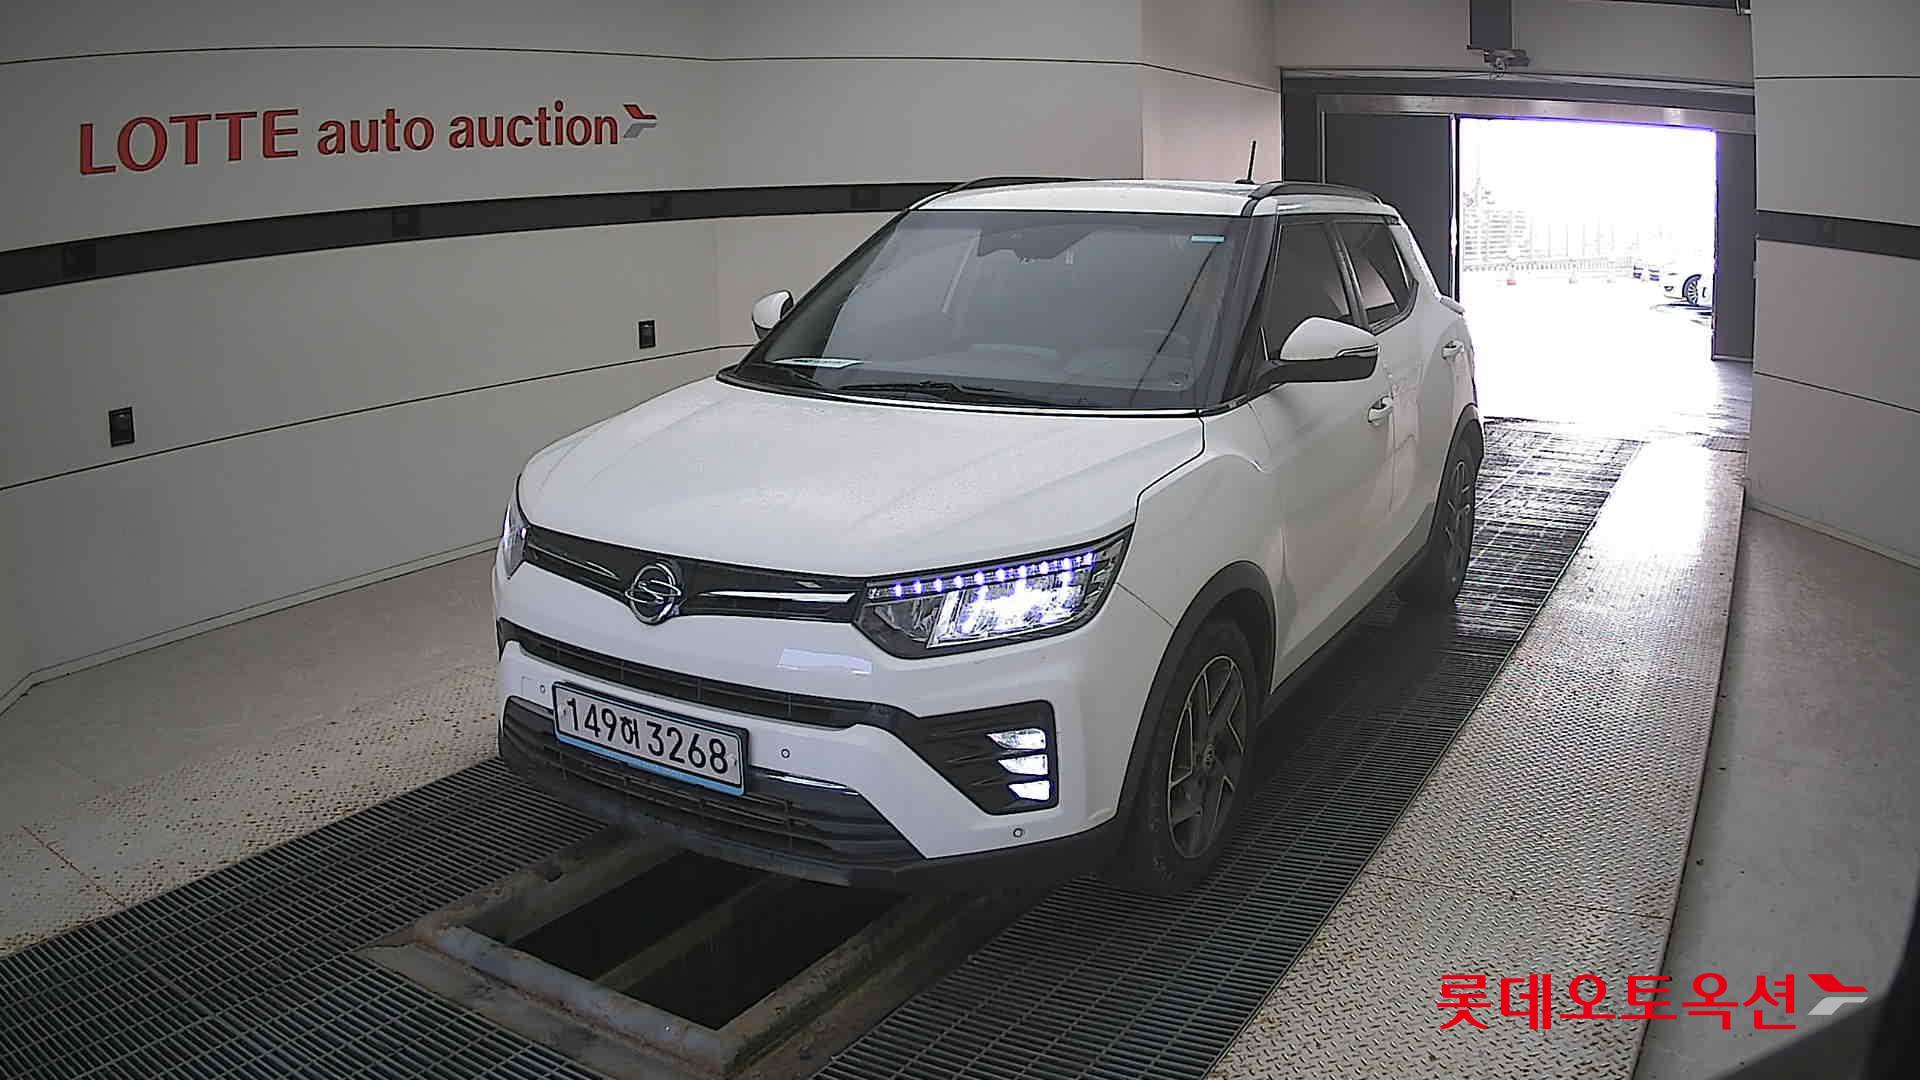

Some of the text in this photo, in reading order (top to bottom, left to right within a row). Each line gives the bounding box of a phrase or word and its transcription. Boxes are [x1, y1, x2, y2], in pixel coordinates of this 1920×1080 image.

[79, 100, 619, 175] LOTTE auto auction
